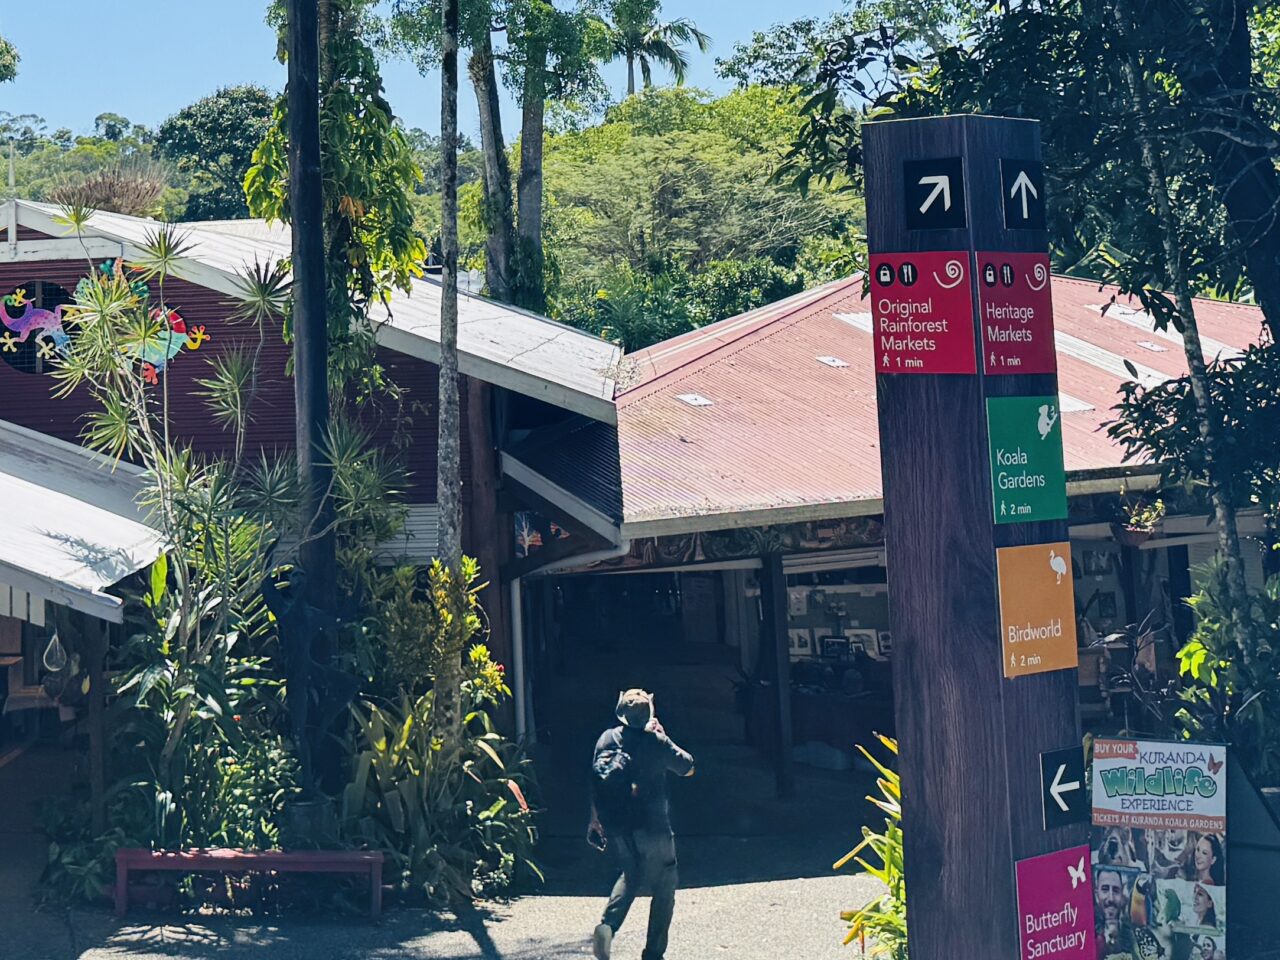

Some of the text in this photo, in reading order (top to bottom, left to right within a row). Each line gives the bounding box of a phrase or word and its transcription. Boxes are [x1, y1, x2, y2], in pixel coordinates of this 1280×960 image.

[878, 297, 932, 317] Original
[986, 302, 1034, 324] Heritage
[880, 317, 948, 333] Rainforest
[987, 325, 1033, 342] Markets
[881, 335, 936, 351] Markets
[896, 356, 923, 368] 1 min
[1000, 355, 1021, 366] 1 min
[996, 446, 1028, 466] Koala
[998, 471, 1045, 490] Gardens
[1010, 503, 1032, 515] 2 min
[1008, 618, 1062, 643] Birdworld
[1020, 654, 1041, 666] 2 min
[1095, 743, 1135, 753] BUY YOUR
[1140, 751, 1206, 765] KURANDA
[1100, 766, 1217, 798] Wildlife
[1121, 798, 1194, 811] EXPERIENCE
[1094, 813, 1223, 830] TICKETS AT KURANDA KOALA GARDENS
[1025, 902, 1077, 934] Butterfly
[1027, 929, 1086, 959] Sanctuary
